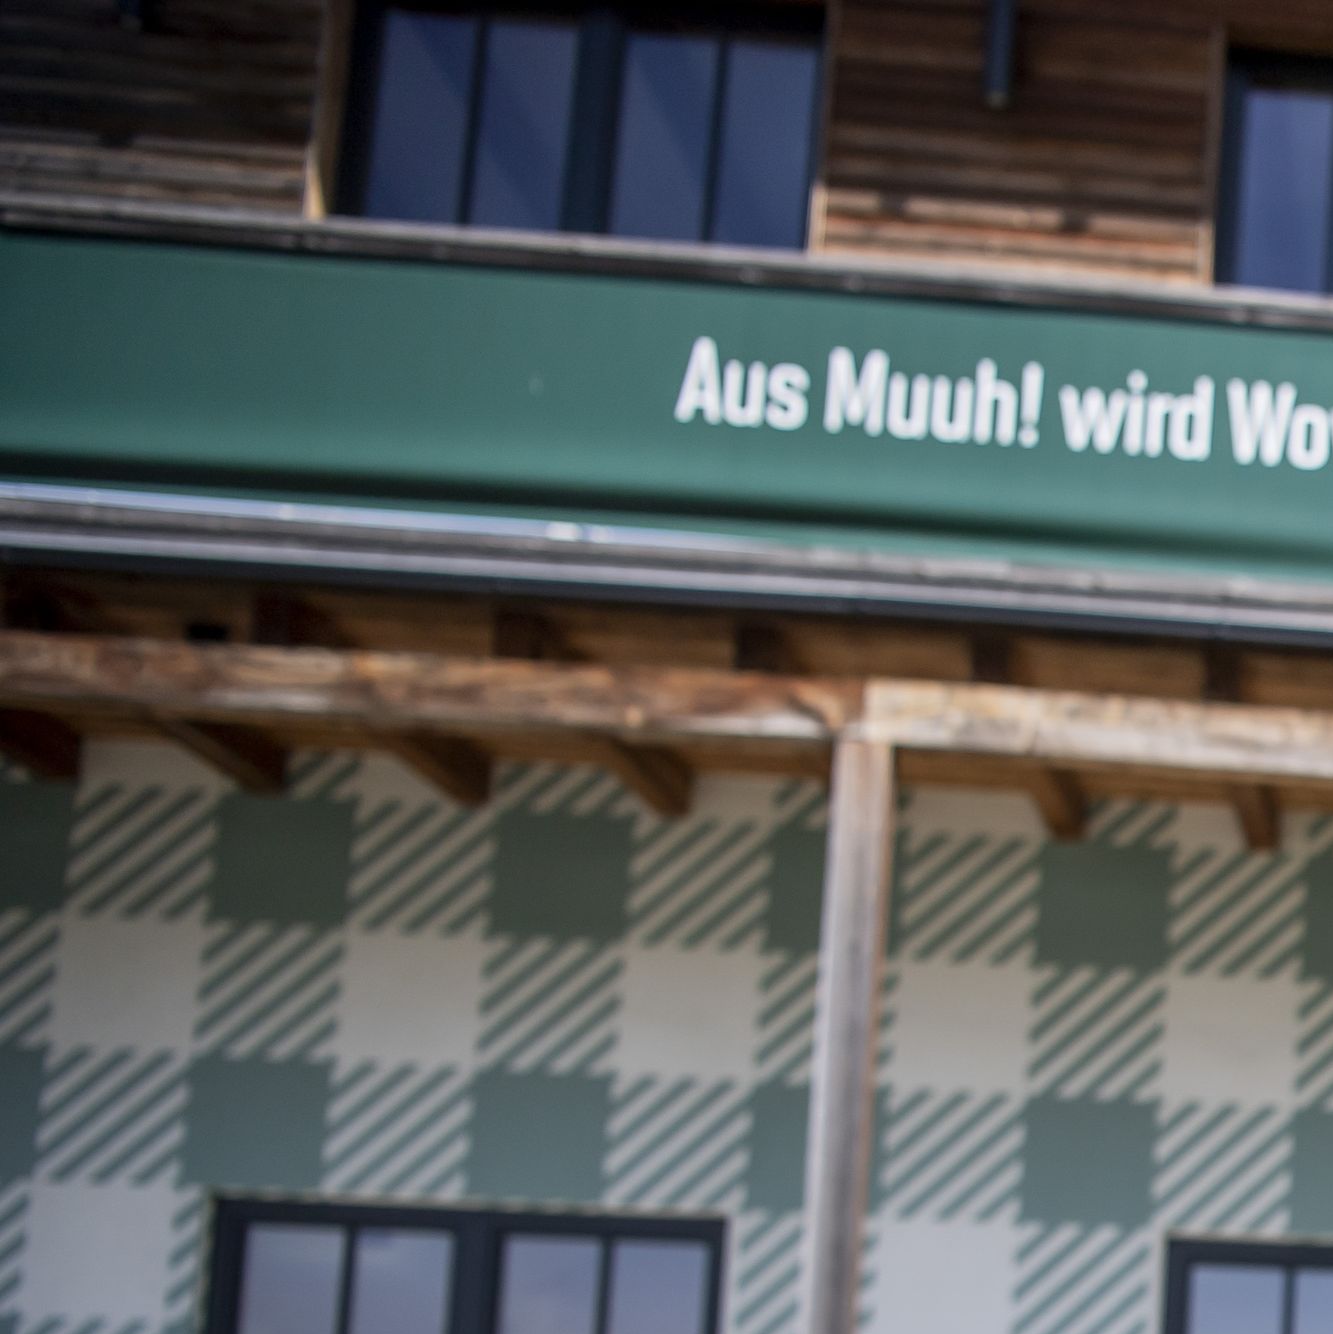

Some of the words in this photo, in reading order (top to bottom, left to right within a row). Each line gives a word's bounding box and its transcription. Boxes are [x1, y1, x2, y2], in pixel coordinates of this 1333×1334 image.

[674, 336, 810, 431] Aus
[823, 345, 1044, 449] Muuh!
[1059, 369, 1215, 463] wird
